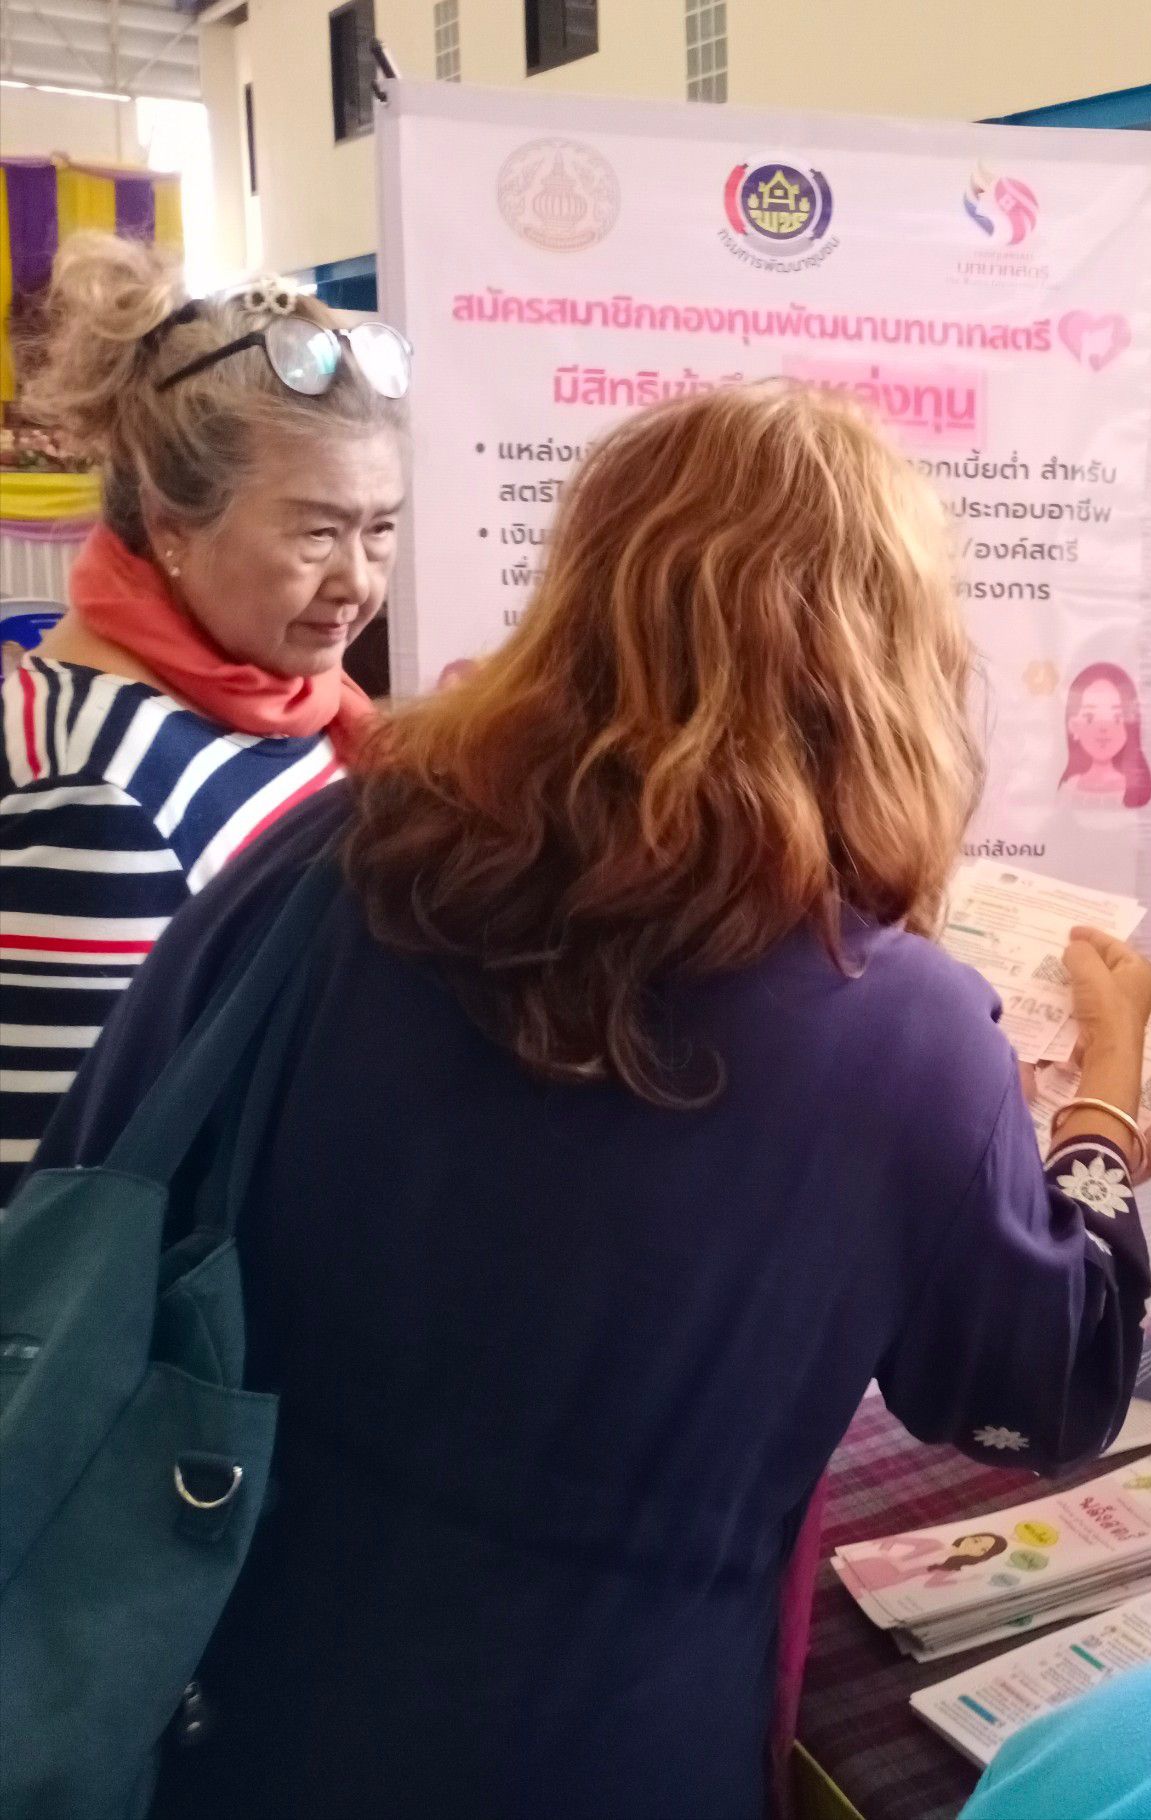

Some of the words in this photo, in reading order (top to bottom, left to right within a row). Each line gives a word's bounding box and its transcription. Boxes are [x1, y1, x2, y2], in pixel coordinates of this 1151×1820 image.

[452, 286, 1052, 351] สมัครสมาชิกกองทุนพัฒนาบทบาทสตรี
[907, 448, 1030, 481] อกเบี้ยต่ำ
[1041, 456, 1117, 485] สำหรับ
[942, 497, 1112, 524] ประกอบอาชีพ
[954, 577, 1051, 601] ครงการ
